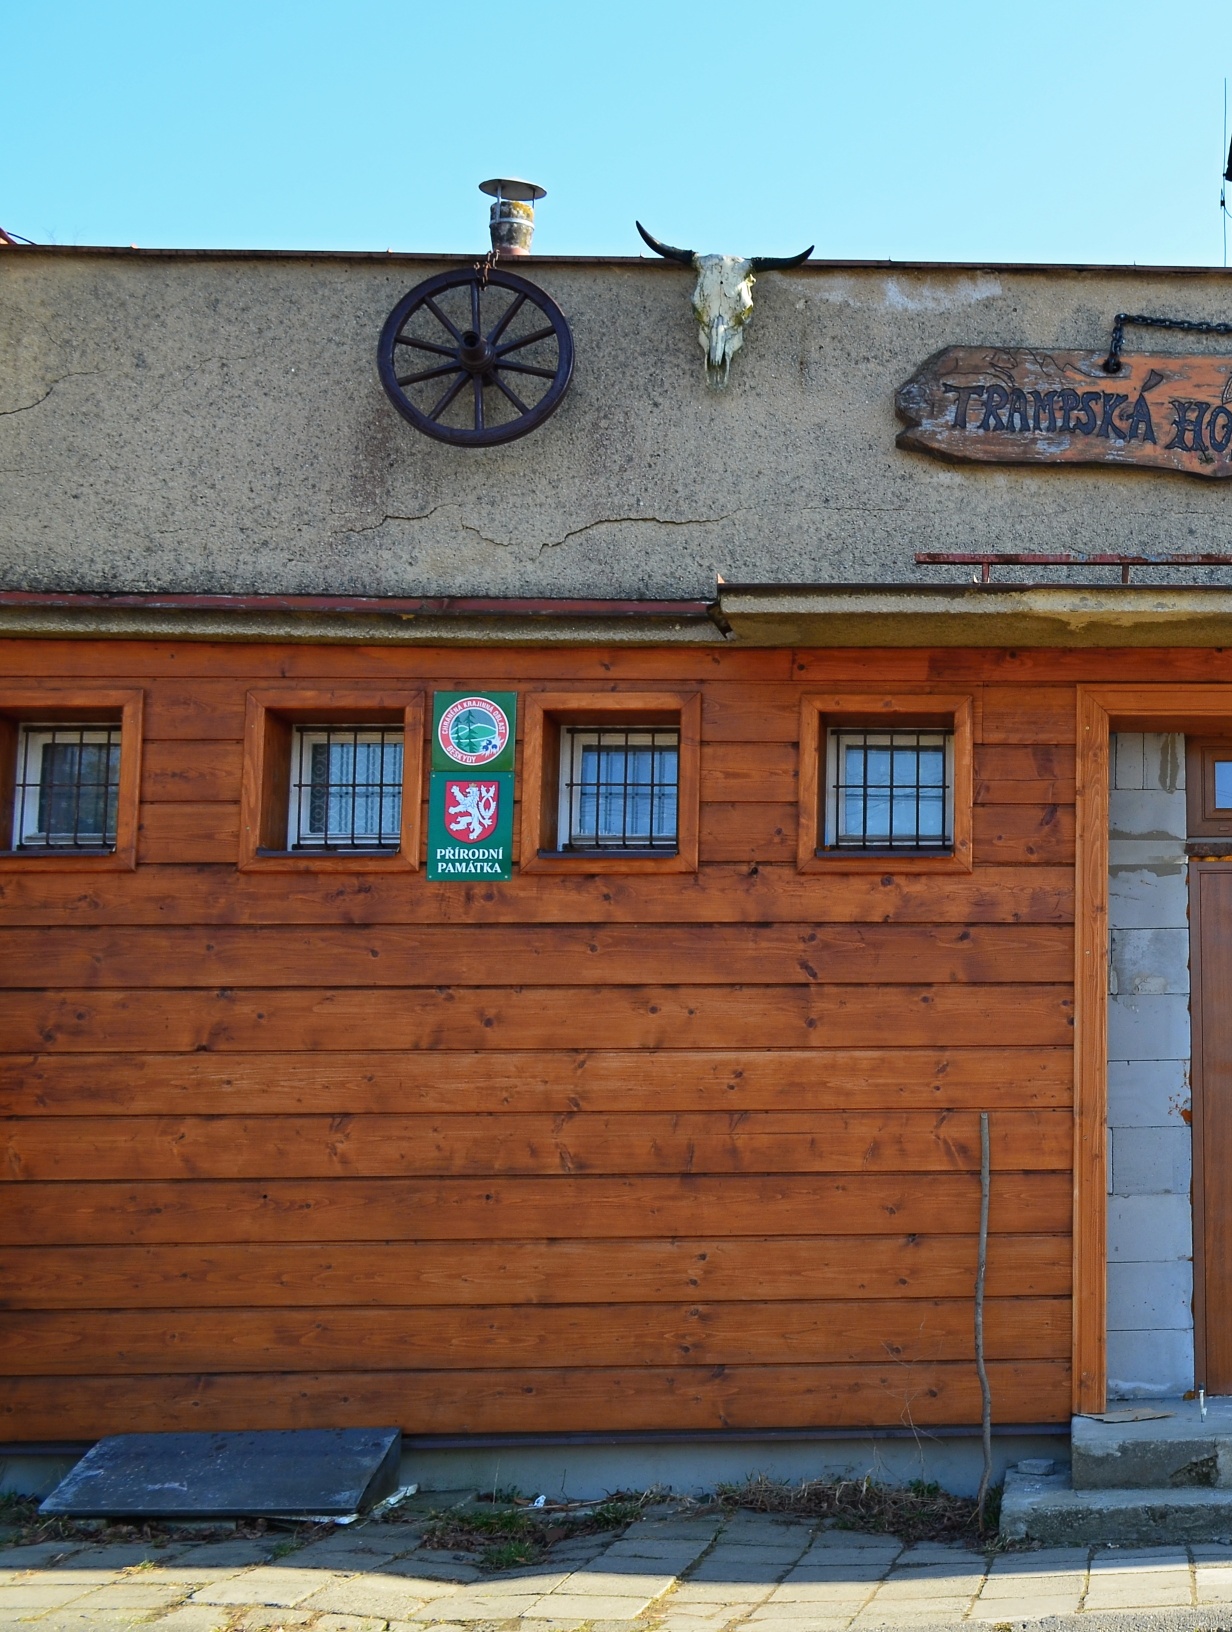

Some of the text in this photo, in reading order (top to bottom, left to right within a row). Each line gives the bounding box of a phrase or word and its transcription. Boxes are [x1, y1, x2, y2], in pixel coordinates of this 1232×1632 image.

[942, 369, 1164, 444] TRAMPSKÁ
[462, 700, 495, 713] KRAJINNÁ
[492, 710, 506, 733] OBLAST
[446, 745, 476, 763] BESKYDY
[436, 846, 503, 860] PŘÍRODNÍ
[437, 861, 501, 873] PAMÁTKA
